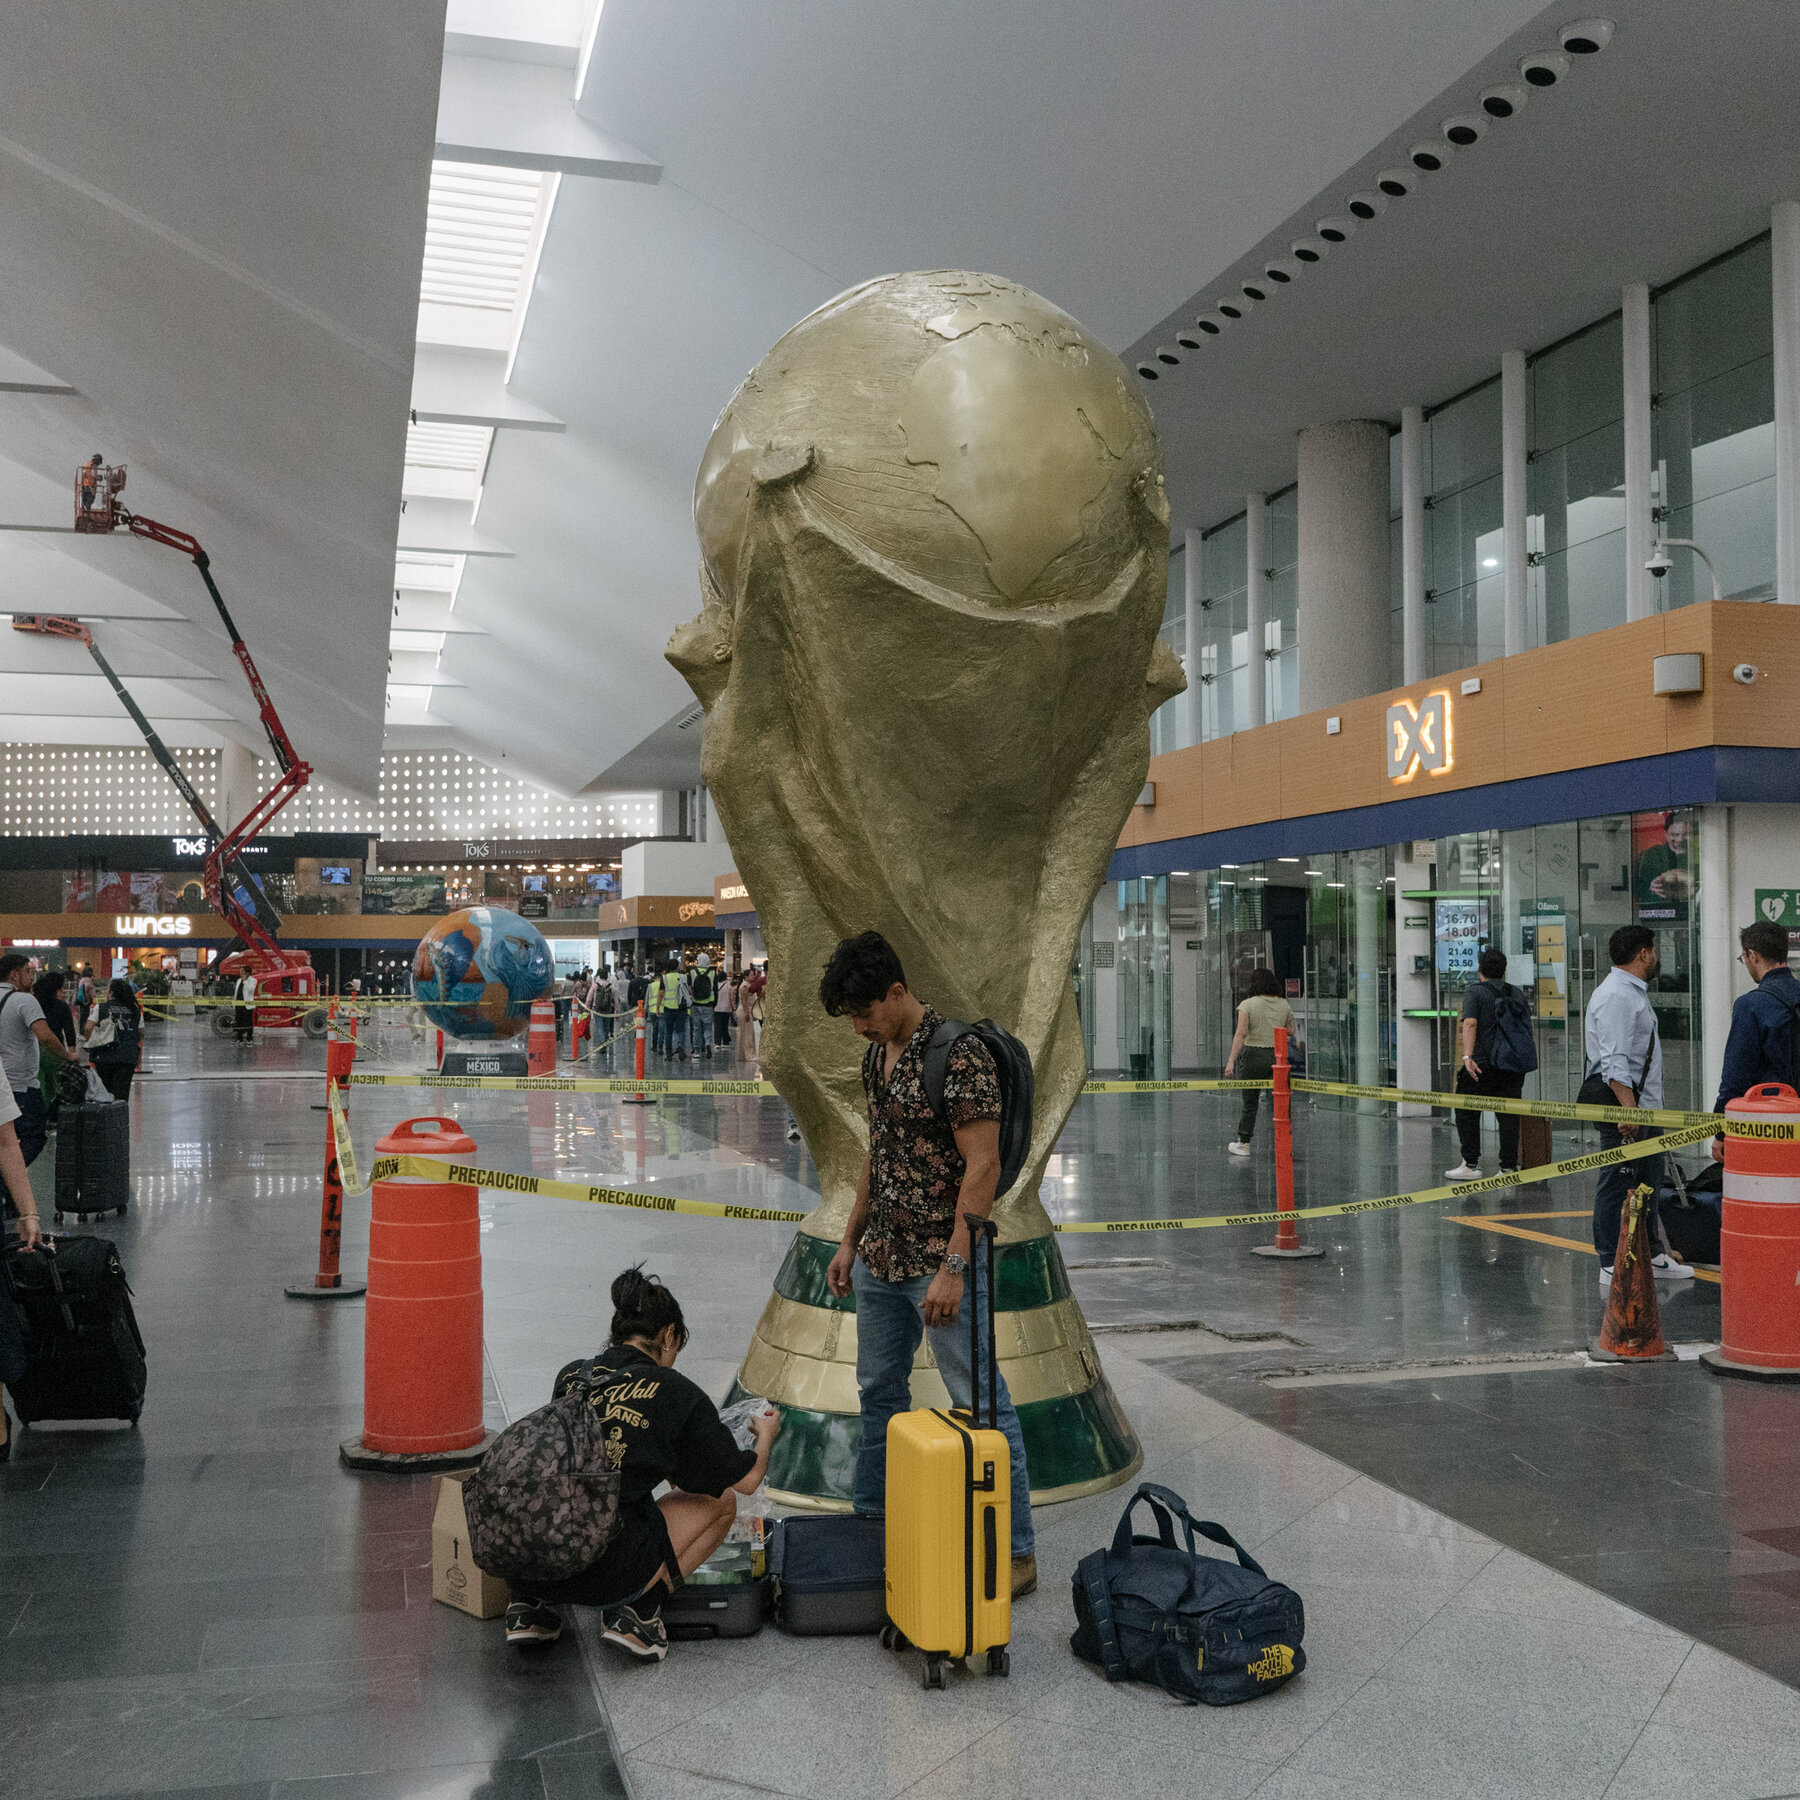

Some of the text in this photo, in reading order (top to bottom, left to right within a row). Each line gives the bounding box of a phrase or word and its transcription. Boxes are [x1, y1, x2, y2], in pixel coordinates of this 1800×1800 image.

[116, 916, 191, 935] WINGS
[1445, 913, 1477, 924] 16.70
[1445, 927, 1477, 937] 18.00
[1448, 948, 1473, 956] 21.40
[1448, 959, 1473, 967] 23.50
[466, 1058, 500, 1072] MÉXICO
[1557, 1149, 1626, 1174] PRECAUCION
[1659, 1122, 1723, 1149] PRECAUCION
[1726, 1121, 1794, 1139] PRECAUCION
[448, 1165, 539, 1193] PRECAUCION
[589, 1187, 676, 1211] PRECAUCION
[604, 1378, 660, 1404] Wall
[1261, 1644, 1281, 1660] THE
[1247, 1656, 1281, 1675] NORTH
[1256, 1666, 1282, 1682] FACE
